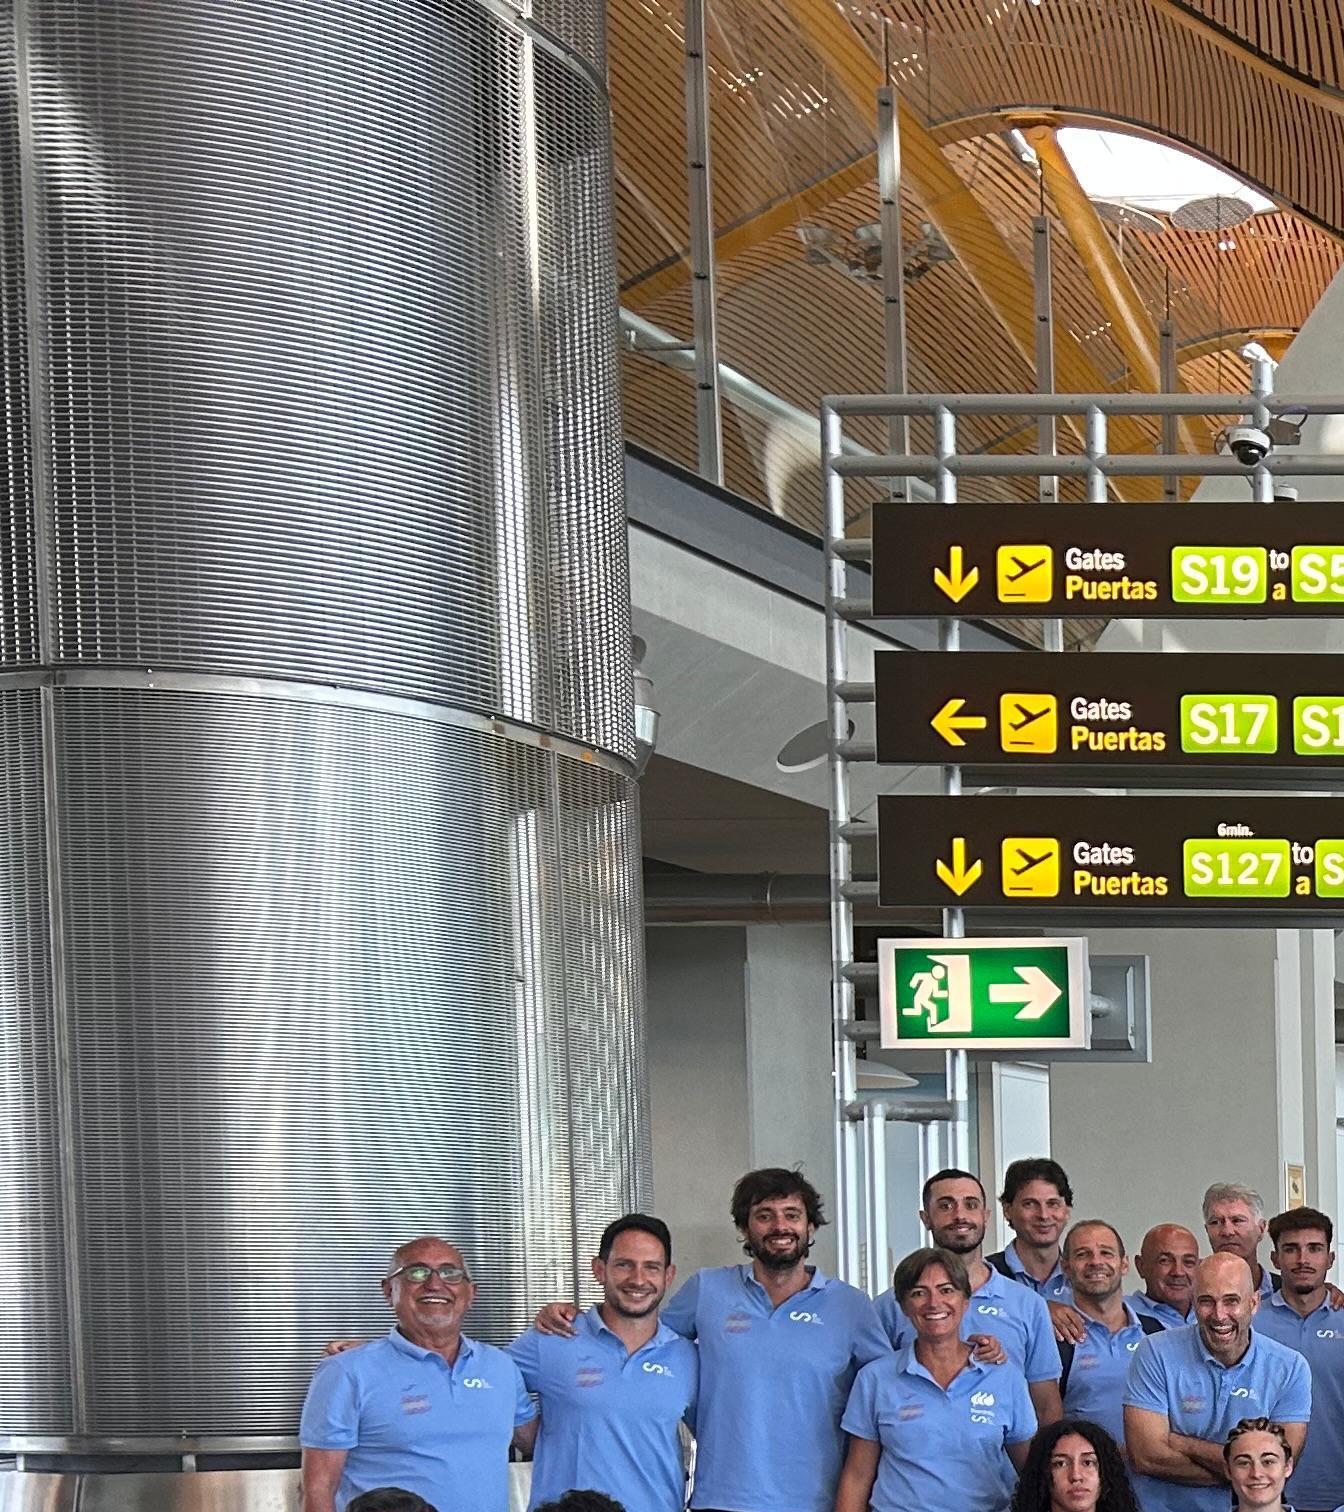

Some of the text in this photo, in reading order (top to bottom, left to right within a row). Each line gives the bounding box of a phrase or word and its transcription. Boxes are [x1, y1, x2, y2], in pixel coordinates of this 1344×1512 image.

[1065, 548, 1126, 572] Gates
[1269, 549, 1289, 570] to
[1180, 555, 1259, 595] S19
[1065, 576, 1158, 602] Puertas
[1272, 582, 1287, 601] a
[1071, 697, 1132, 721] Gates
[1189, 703, 1270, 745] S17
[1071, 726, 1166, 751] Puertas
[1073, 842, 1135, 866] Gates
[1292, 842, 1314, 865] to
[1191, 852, 1282, 887] S127
[1073, 872, 1168, 897] Puertas
[1295, 875, 1311, 897] a
